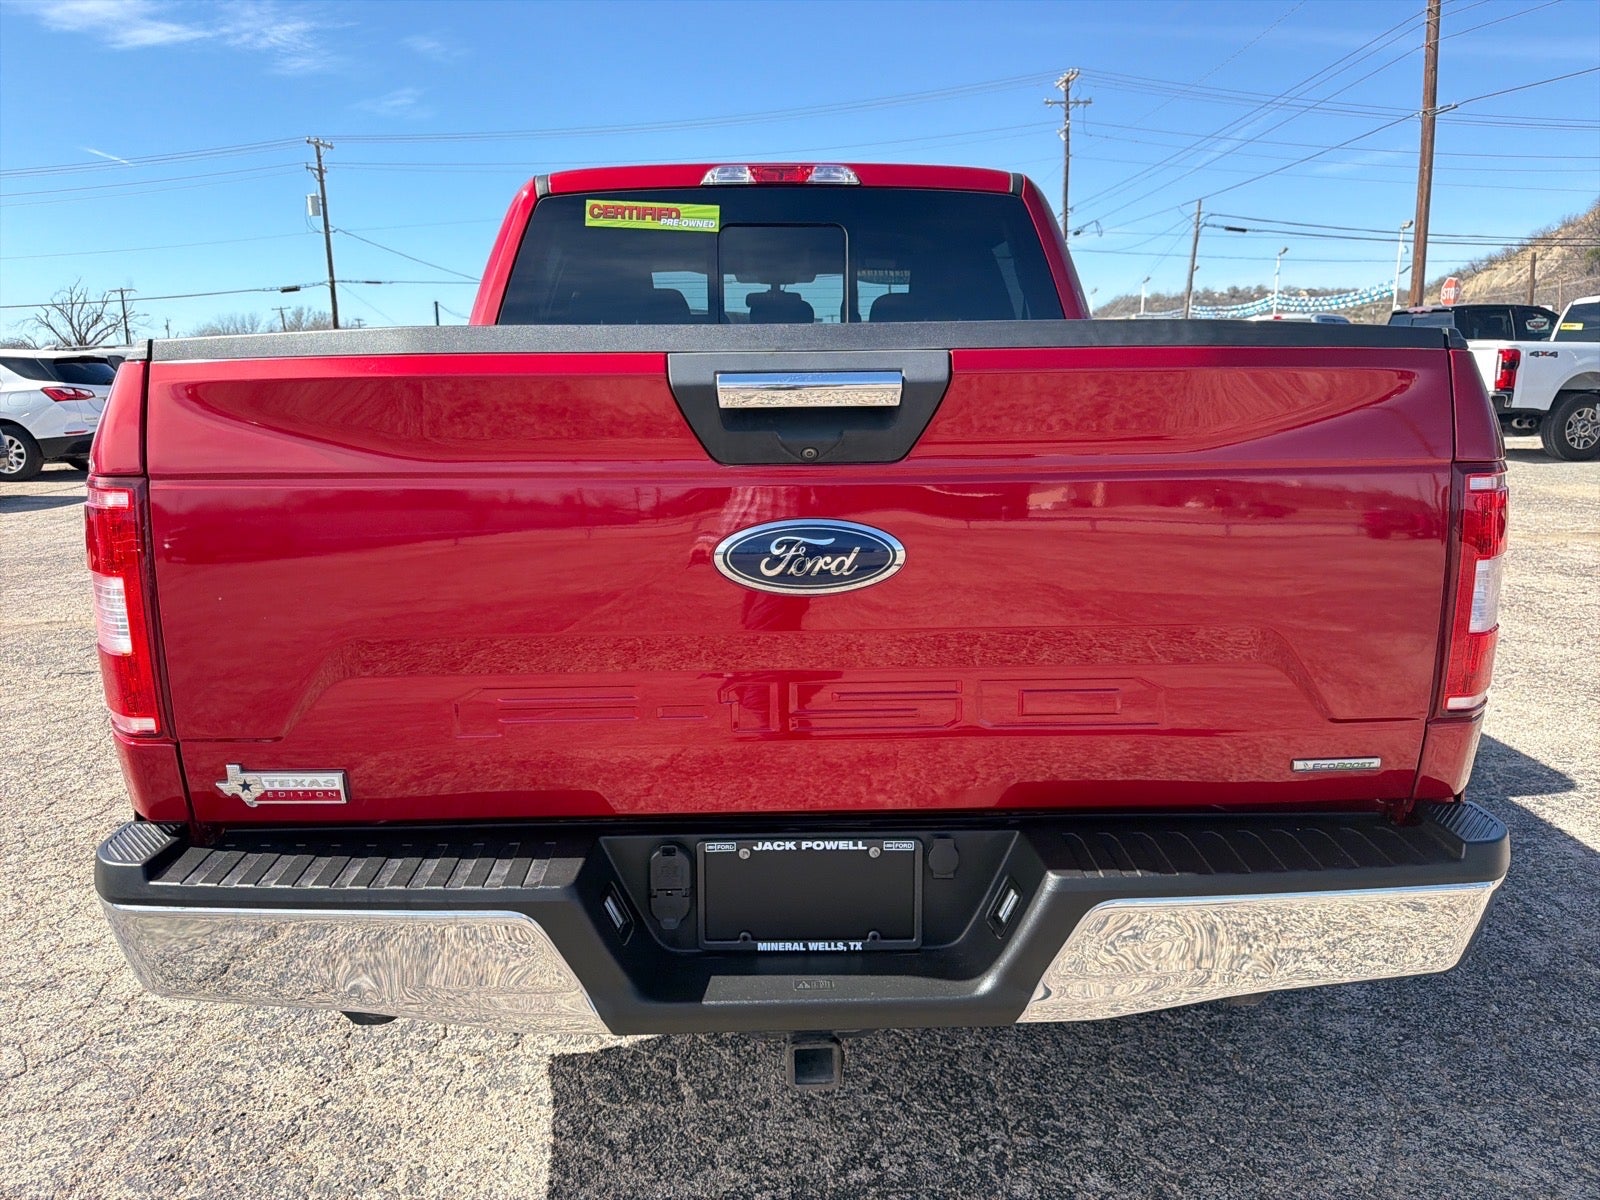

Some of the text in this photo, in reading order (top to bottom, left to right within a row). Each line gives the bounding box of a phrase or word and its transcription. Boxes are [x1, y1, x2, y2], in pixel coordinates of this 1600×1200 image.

[588, 203, 681, 221] CERTIFIED
[660, 218, 716, 229] PRE-OWNED
[1442, 287, 1460, 300] STOP
[760, 536, 862, 577] Ford
[264, 778, 337, 788] TEXAS
[752, 840, 868, 851] JACK POWELL
[757, 942, 862, 952] MINERAL WELLS, TX
